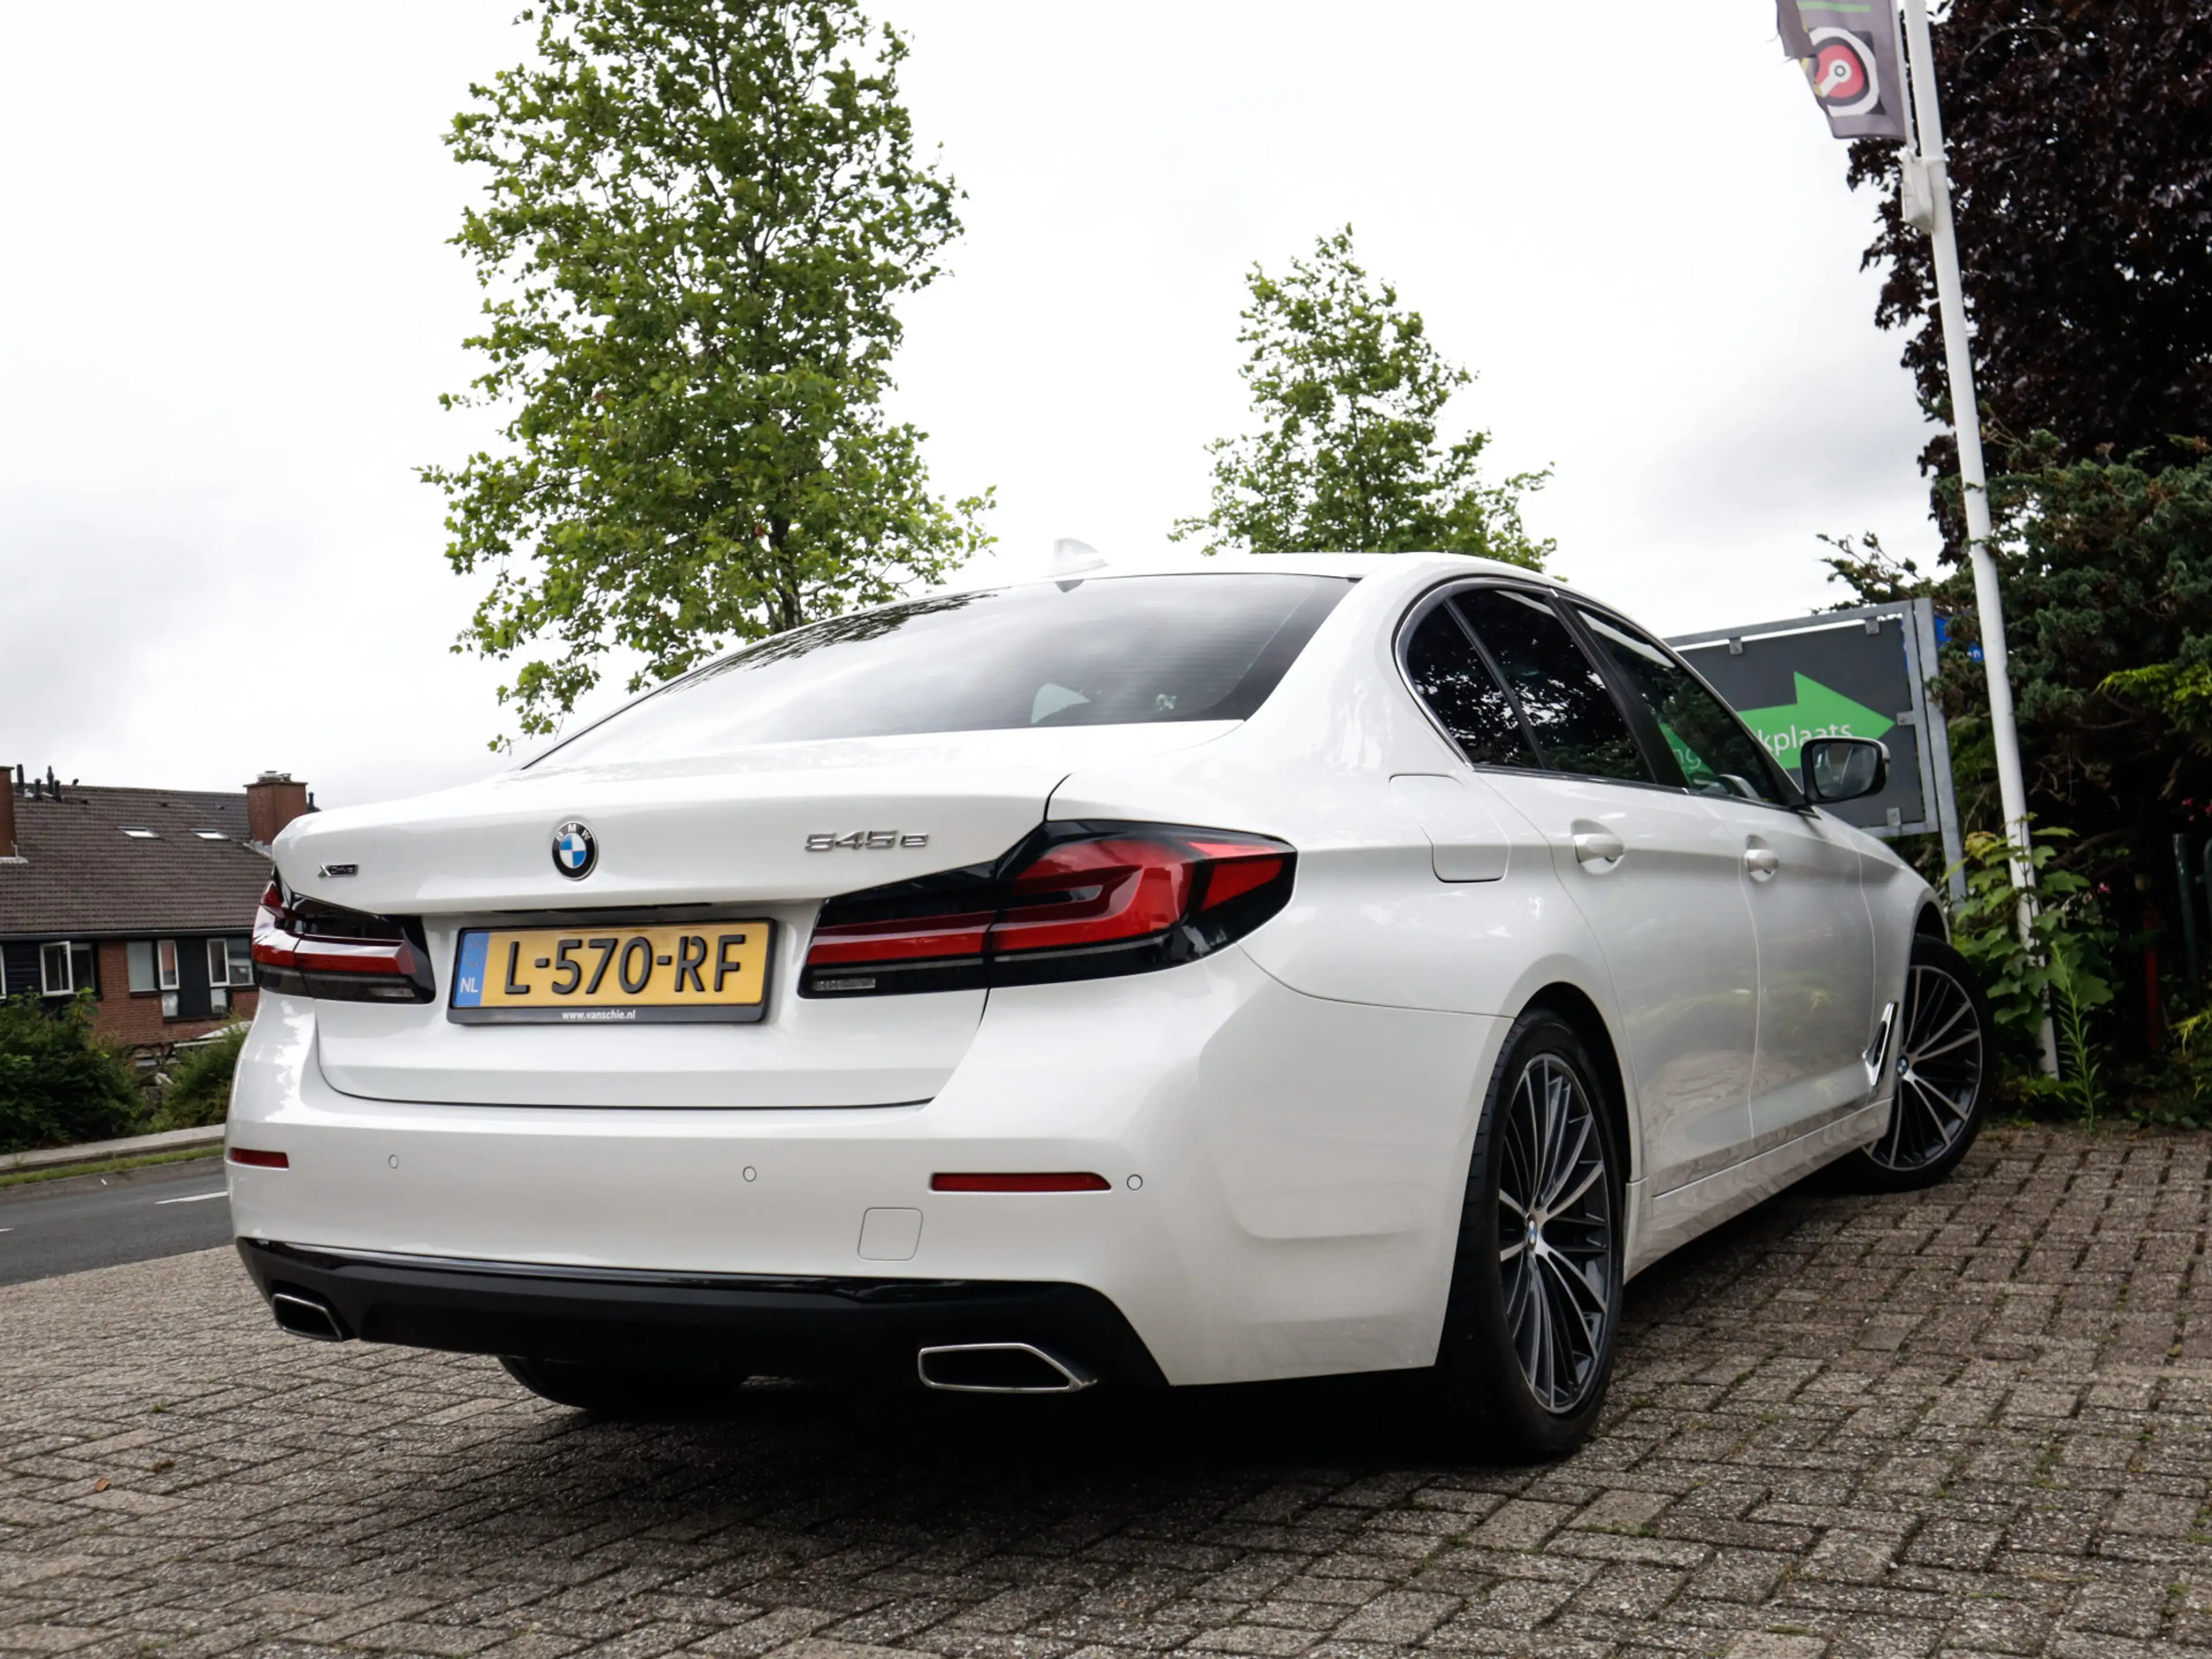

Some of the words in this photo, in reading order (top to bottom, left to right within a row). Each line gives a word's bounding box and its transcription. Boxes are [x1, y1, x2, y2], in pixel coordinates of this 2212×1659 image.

[556, 823, 591, 841] BMW
[804, 830, 929, 853] 545e
[504, 934, 746, 995] L-570-RF
[460, 976, 479, 994] NL
[562, 1009, 637, 1020] www.vanschie.nl
